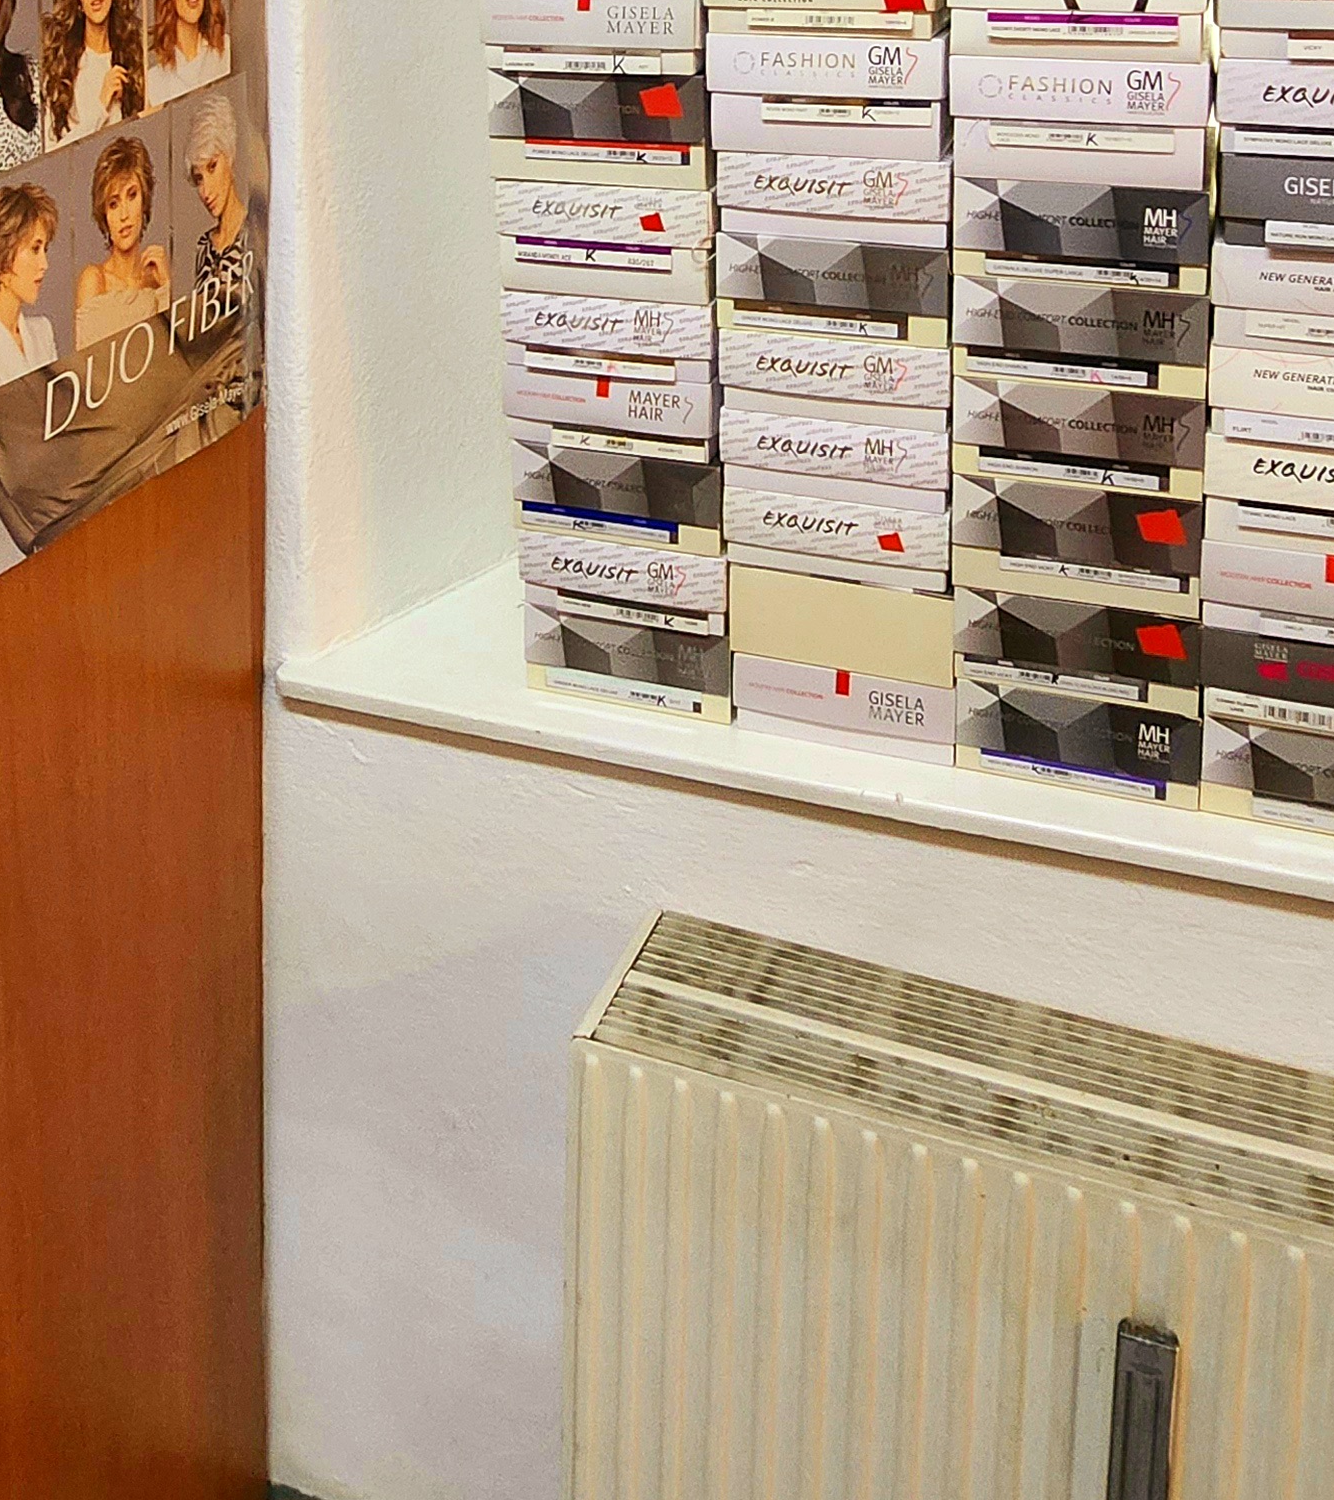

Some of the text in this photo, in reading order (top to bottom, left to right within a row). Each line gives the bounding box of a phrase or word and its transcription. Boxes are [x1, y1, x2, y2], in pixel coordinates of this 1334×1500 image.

[607, 7, 674, 20] GISELA
[607, 21, 674, 34] MAYER
[761, 52, 856, 69] FASHION
[868, 46, 901, 65] GM
[868, 75, 904, 85] MAYER
[869, 66, 903, 76] GISELA
[1126, 70, 1163, 91] GM
[1008, 75, 1113, 96] FASHION
[1127, 92, 1165, 102] GISELA
[1127, 100, 1165, 111] MAYER
[754, 175, 852, 195] EXQUISIT
[863, 171, 893, 188] GM
[533, 200, 623, 219] EXQUISIT
[1144, 208, 1178, 227] MH
[1144, 227, 1178, 238] MAYER
[1259, 272, 1286, 282] NEW
[535, 312, 624, 332] EXQUISIT
[1143, 310, 1175, 329] MH
[44, 250, 254, 442] DUO FIBER
[756, 356, 854, 378] EXQUISIT
[864, 356, 893, 374] GM
[1253, 369, 1280, 380] NEW
[629, 390, 680, 409] MAYER
[628, 405, 663, 422] HAIR
[1143, 415, 1174, 434] MH
[757, 436, 853, 459] EXQUISIT
[763, 510, 859, 535] EXQUISIT
[551, 556, 638, 582] EXQUISIT
[868, 691, 925, 712] GISELA
[868, 706, 925, 726] MAYER
[1138, 723, 1170, 744] MH
